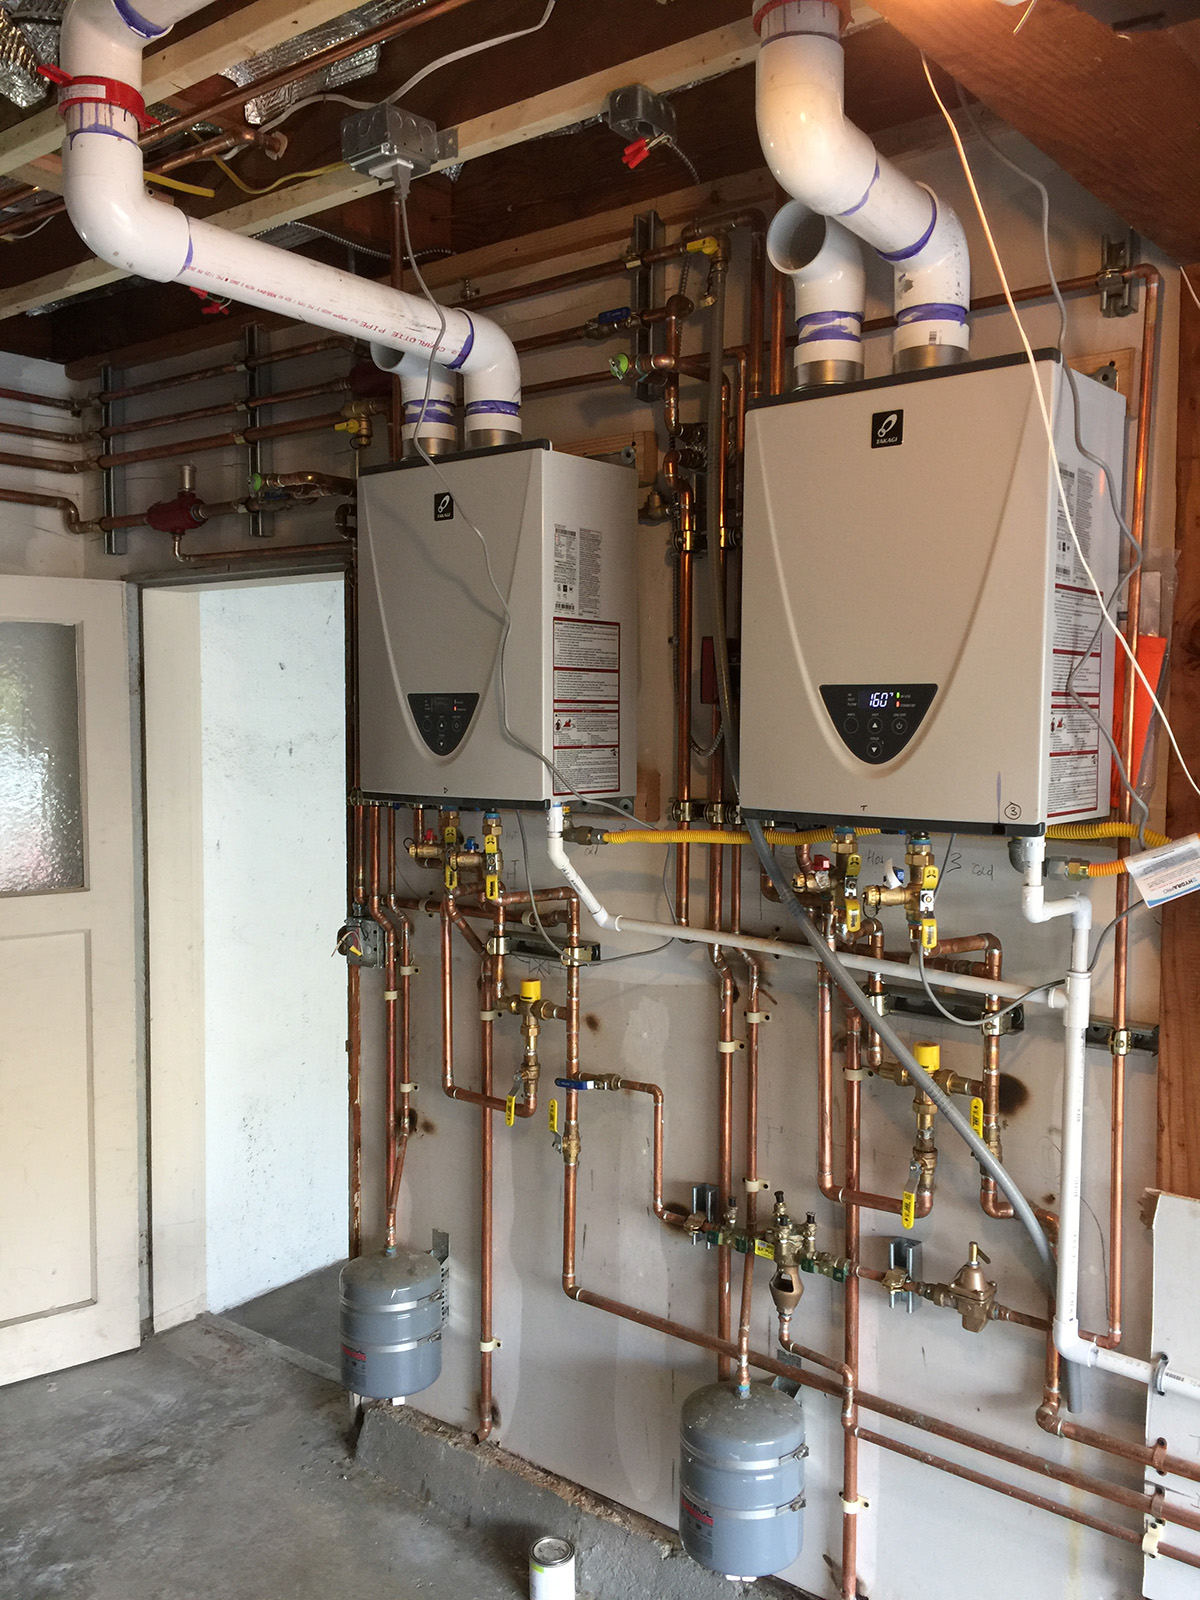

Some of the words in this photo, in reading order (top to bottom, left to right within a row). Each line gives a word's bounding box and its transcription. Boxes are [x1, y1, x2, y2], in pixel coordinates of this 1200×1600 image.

[360, 321, 386, 334] PIPE
[876, 437, 898, 445] TAKAGI
[946, 852, 962, 873] 3
